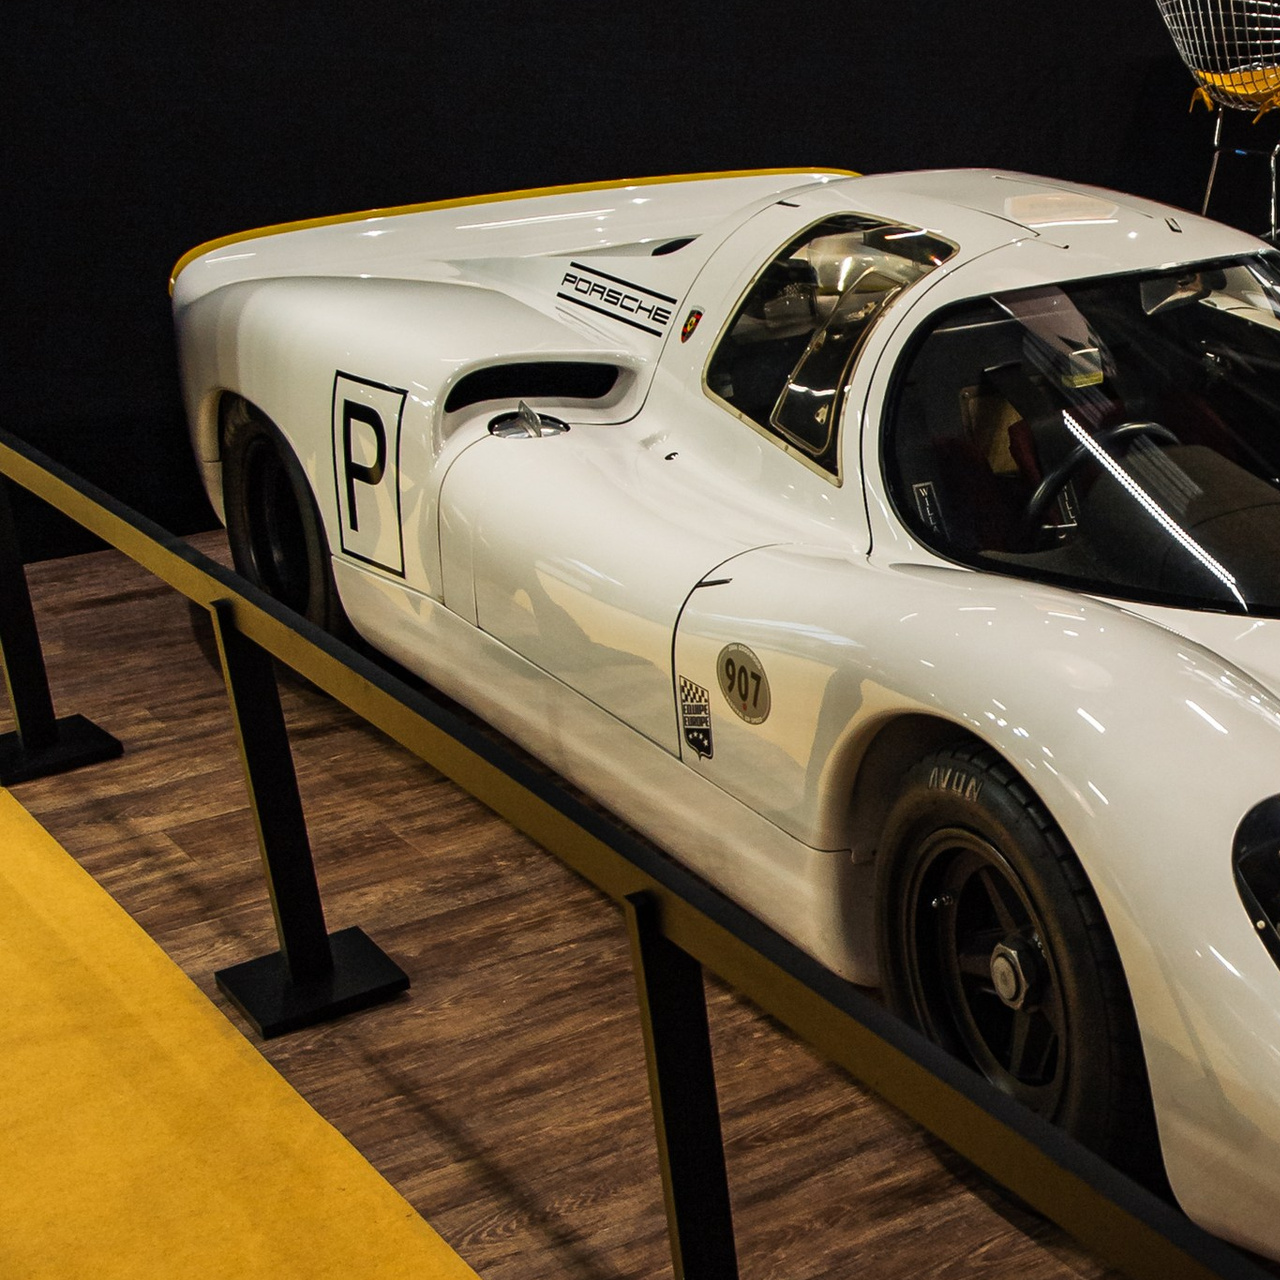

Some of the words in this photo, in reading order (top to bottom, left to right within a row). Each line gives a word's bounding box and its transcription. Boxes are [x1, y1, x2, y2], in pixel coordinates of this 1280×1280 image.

[561, 272, 672, 326] PORSCHE
[343, 398, 387, 532] P
[725, 657, 762, 708] 907
[928, 767, 983, 802] AVON
